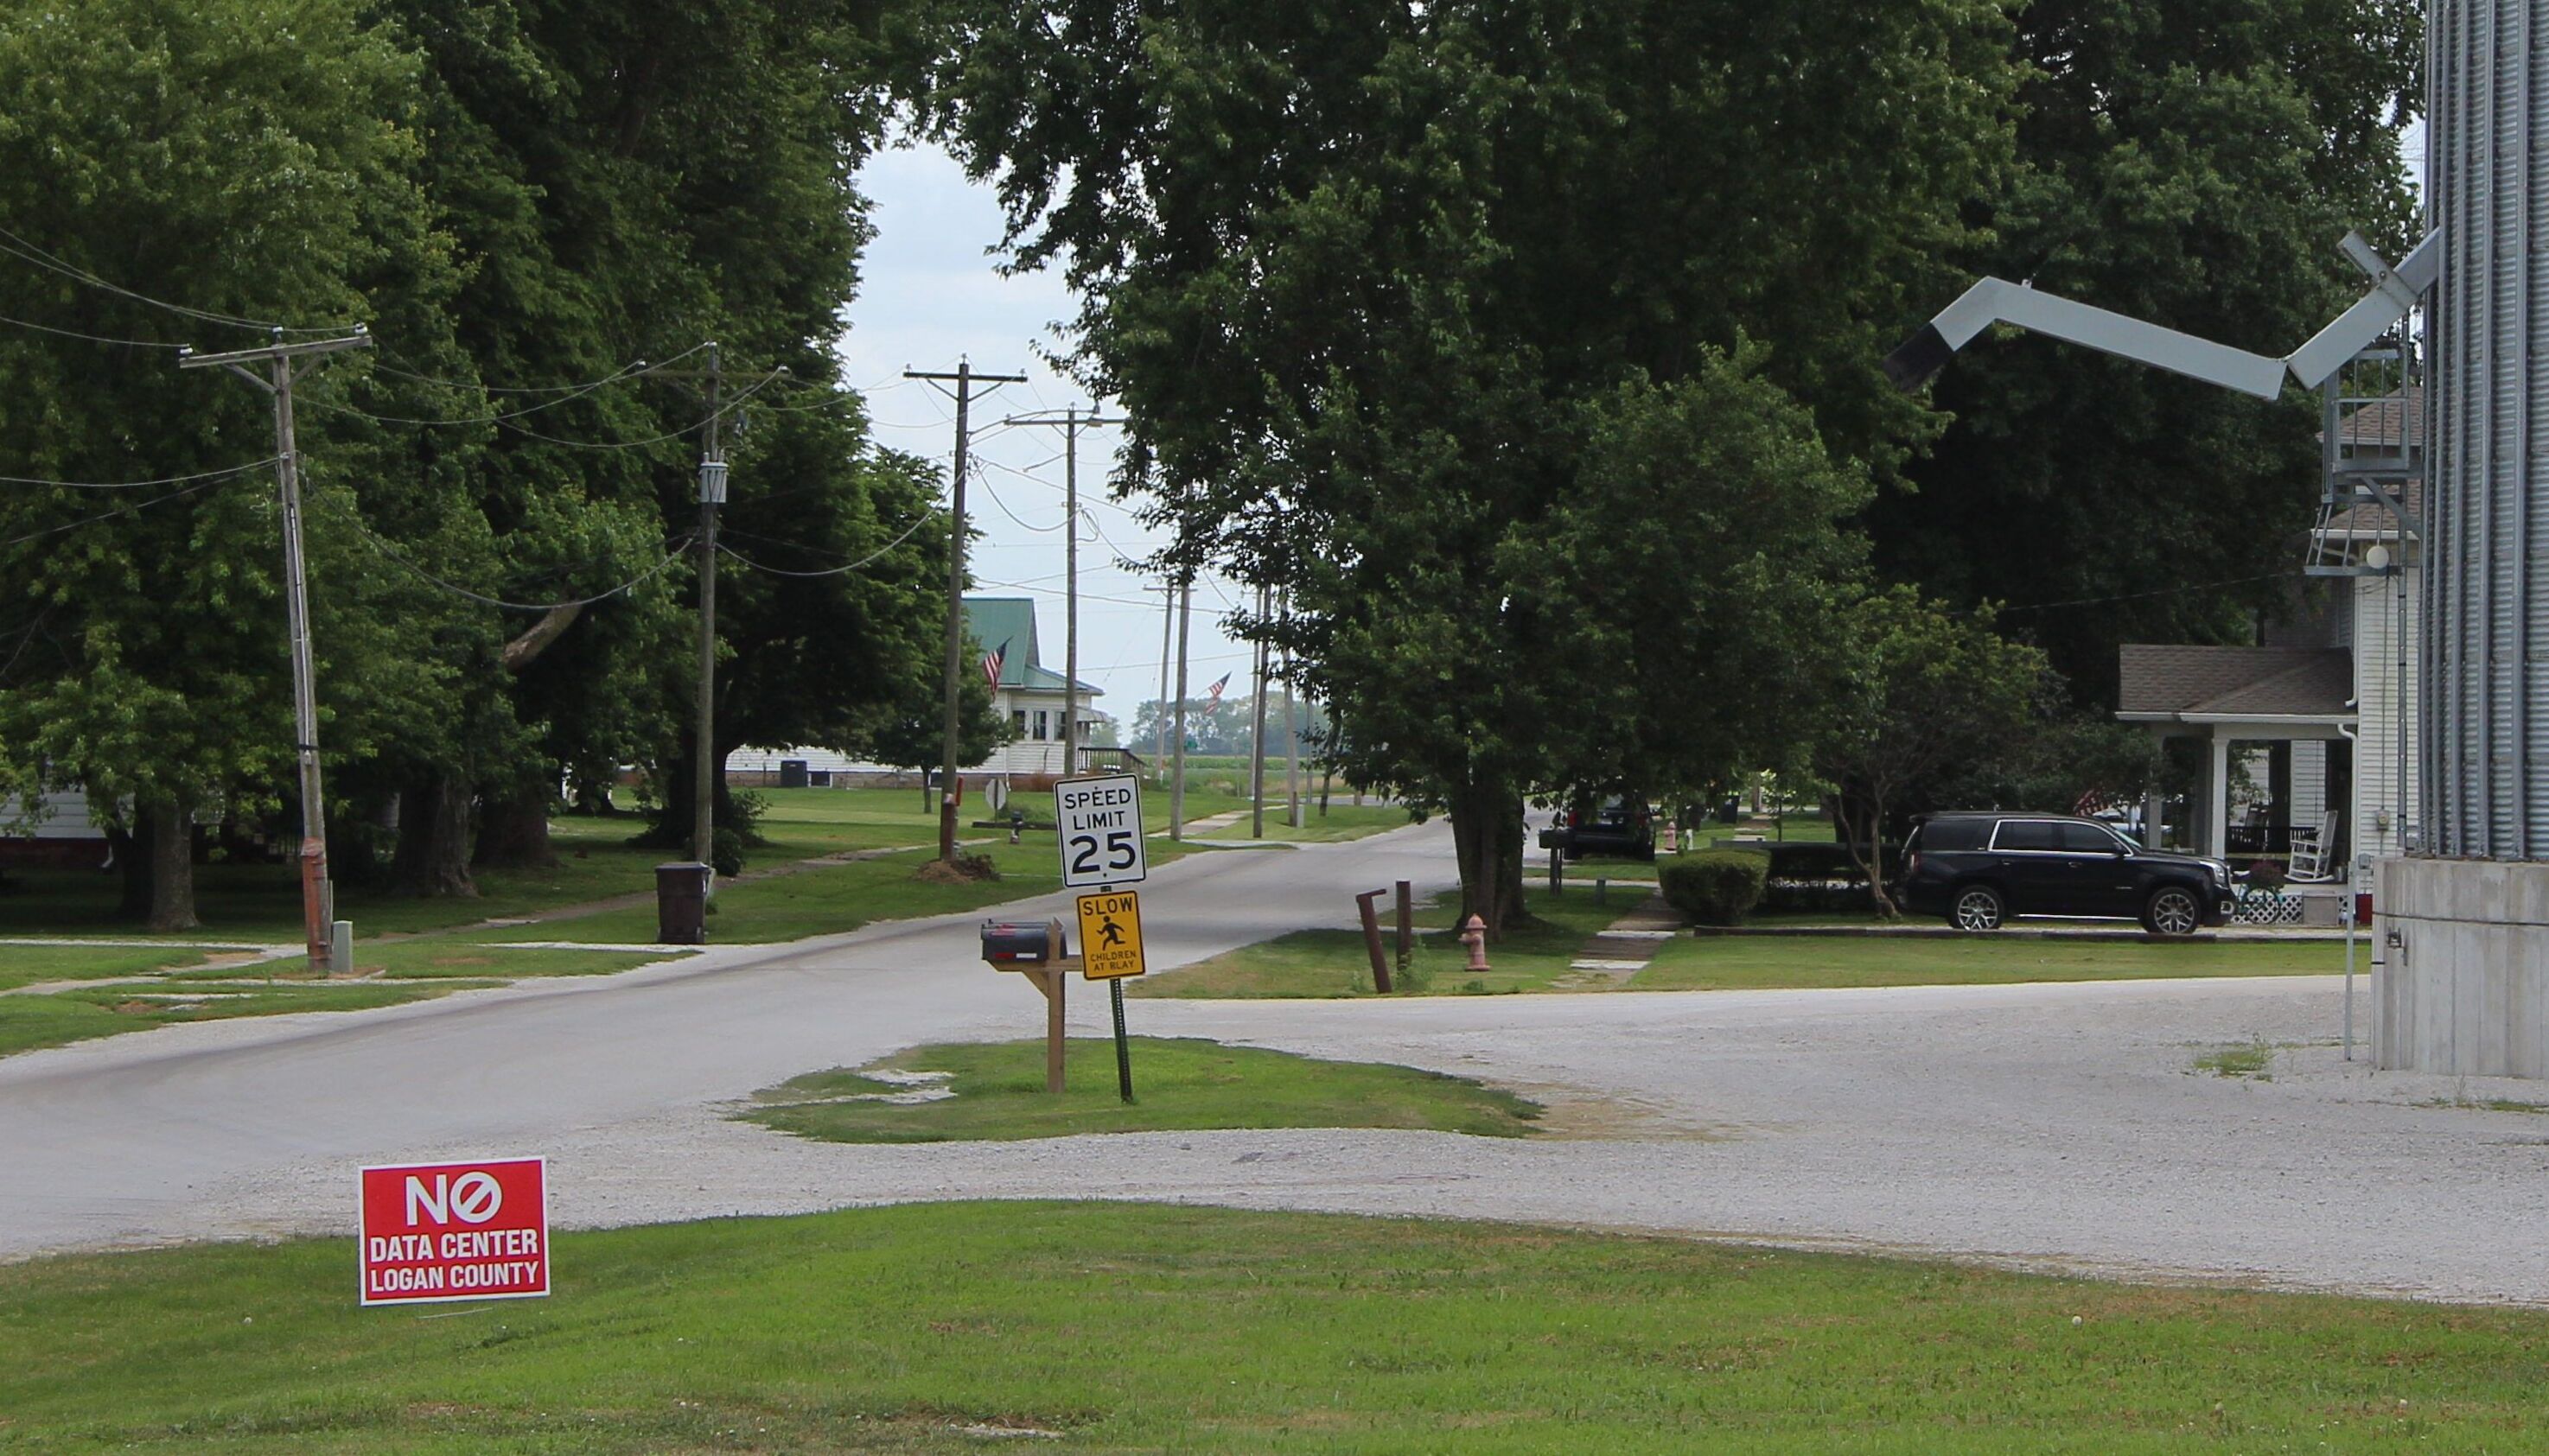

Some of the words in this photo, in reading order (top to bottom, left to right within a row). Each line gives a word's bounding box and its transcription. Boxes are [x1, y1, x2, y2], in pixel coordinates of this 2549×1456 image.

[1065, 789, 1131, 810] SPEED
[1073, 811, 1125, 830] LIMIT
[1069, 831, 1137, 874] 25
[1083, 896, 1133, 916] SLOW
[1090, 950, 1137, 962] CHILDREN
[1093, 962, 1105, 971] AT
[405, 1171, 503, 1226] NO
[370, 1234, 435, 1262] DATA
[441, 1228, 538, 1259] CENTER
[370, 1266, 444, 1292] LOGAN
[449, 1261, 539, 1288] COUNTY
